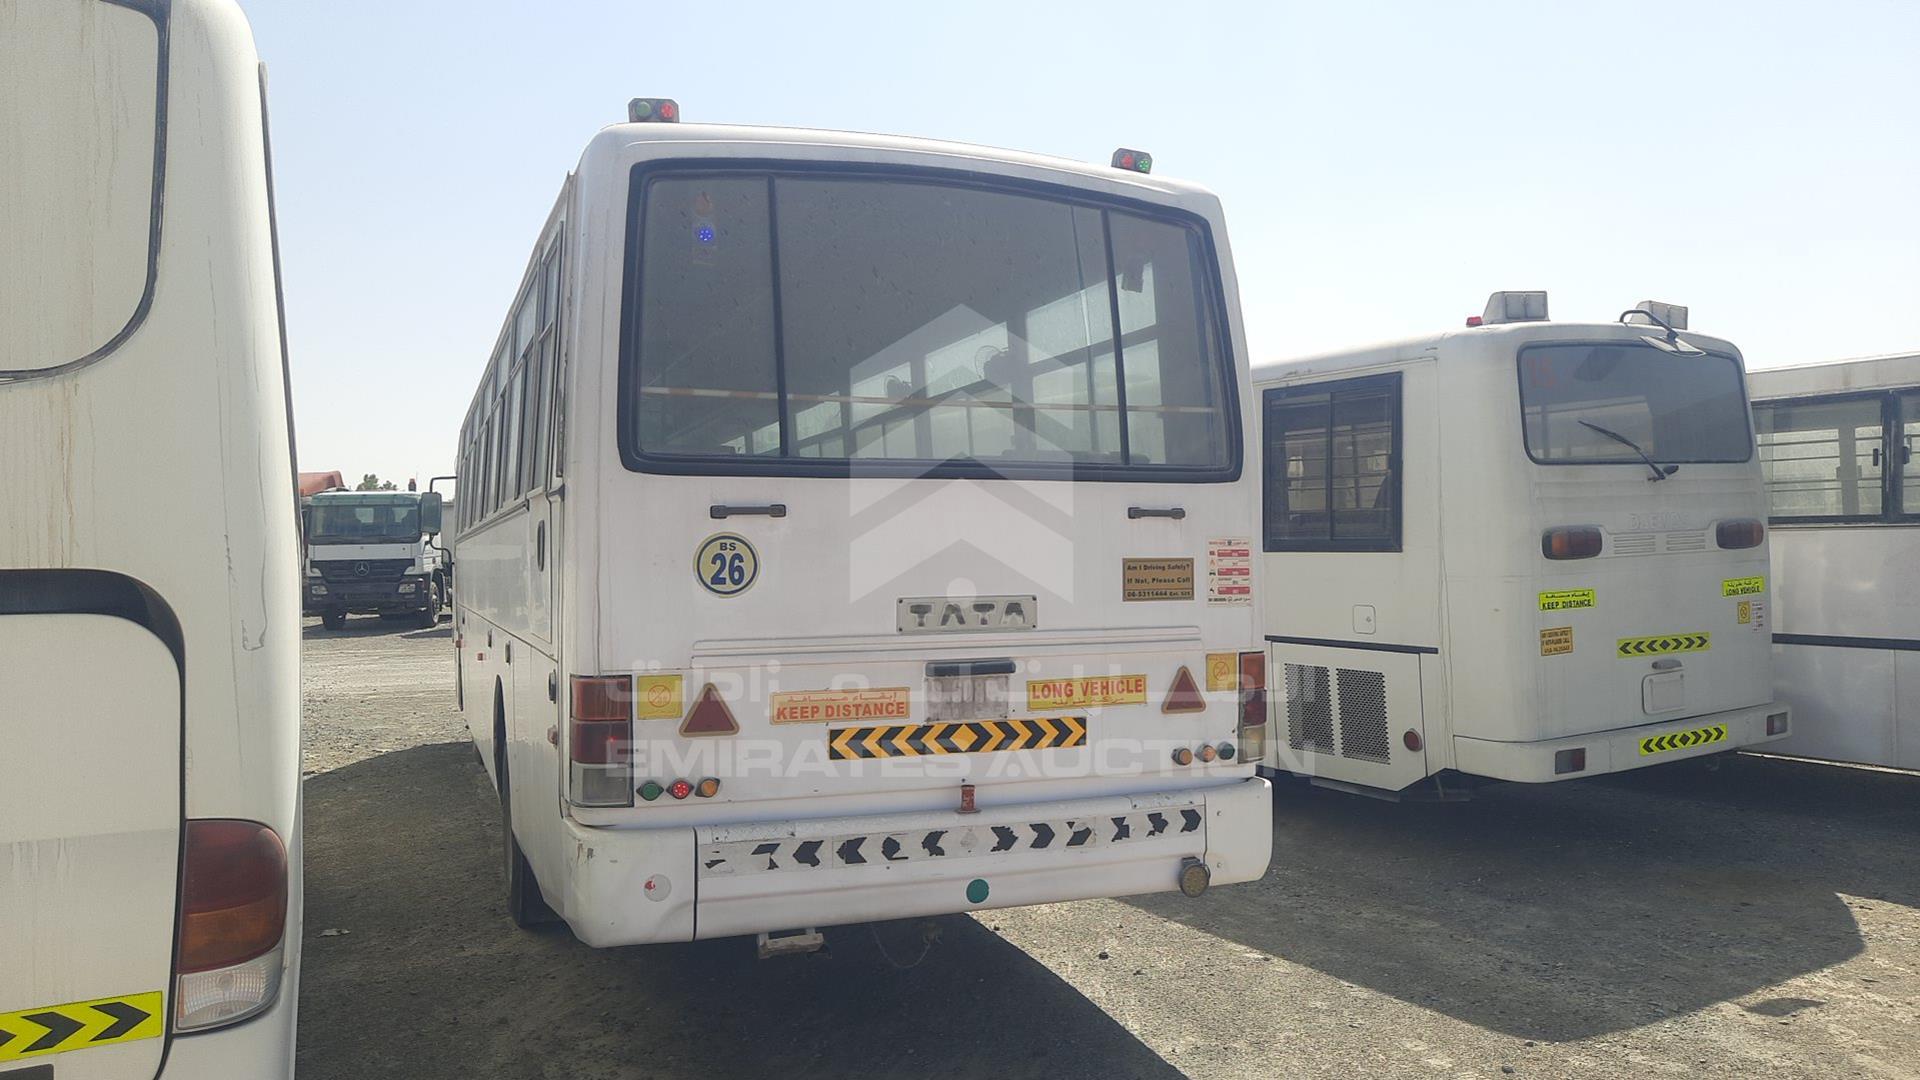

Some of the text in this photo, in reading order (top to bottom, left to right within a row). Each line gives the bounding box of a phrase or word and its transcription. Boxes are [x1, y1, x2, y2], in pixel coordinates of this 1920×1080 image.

[719, 542, 737, 551] BS
[711, 552, 745, 585] 26
[1167, 563, 1190, 571] Safely?
[909, 602, 1026, 626] TATA
[1542, 599, 1592, 610] KEEP DISTANCE
[1031, 678, 1143, 700] LONG VEHICLE
[776, 701, 905, 721] KEEP DISTANCE
